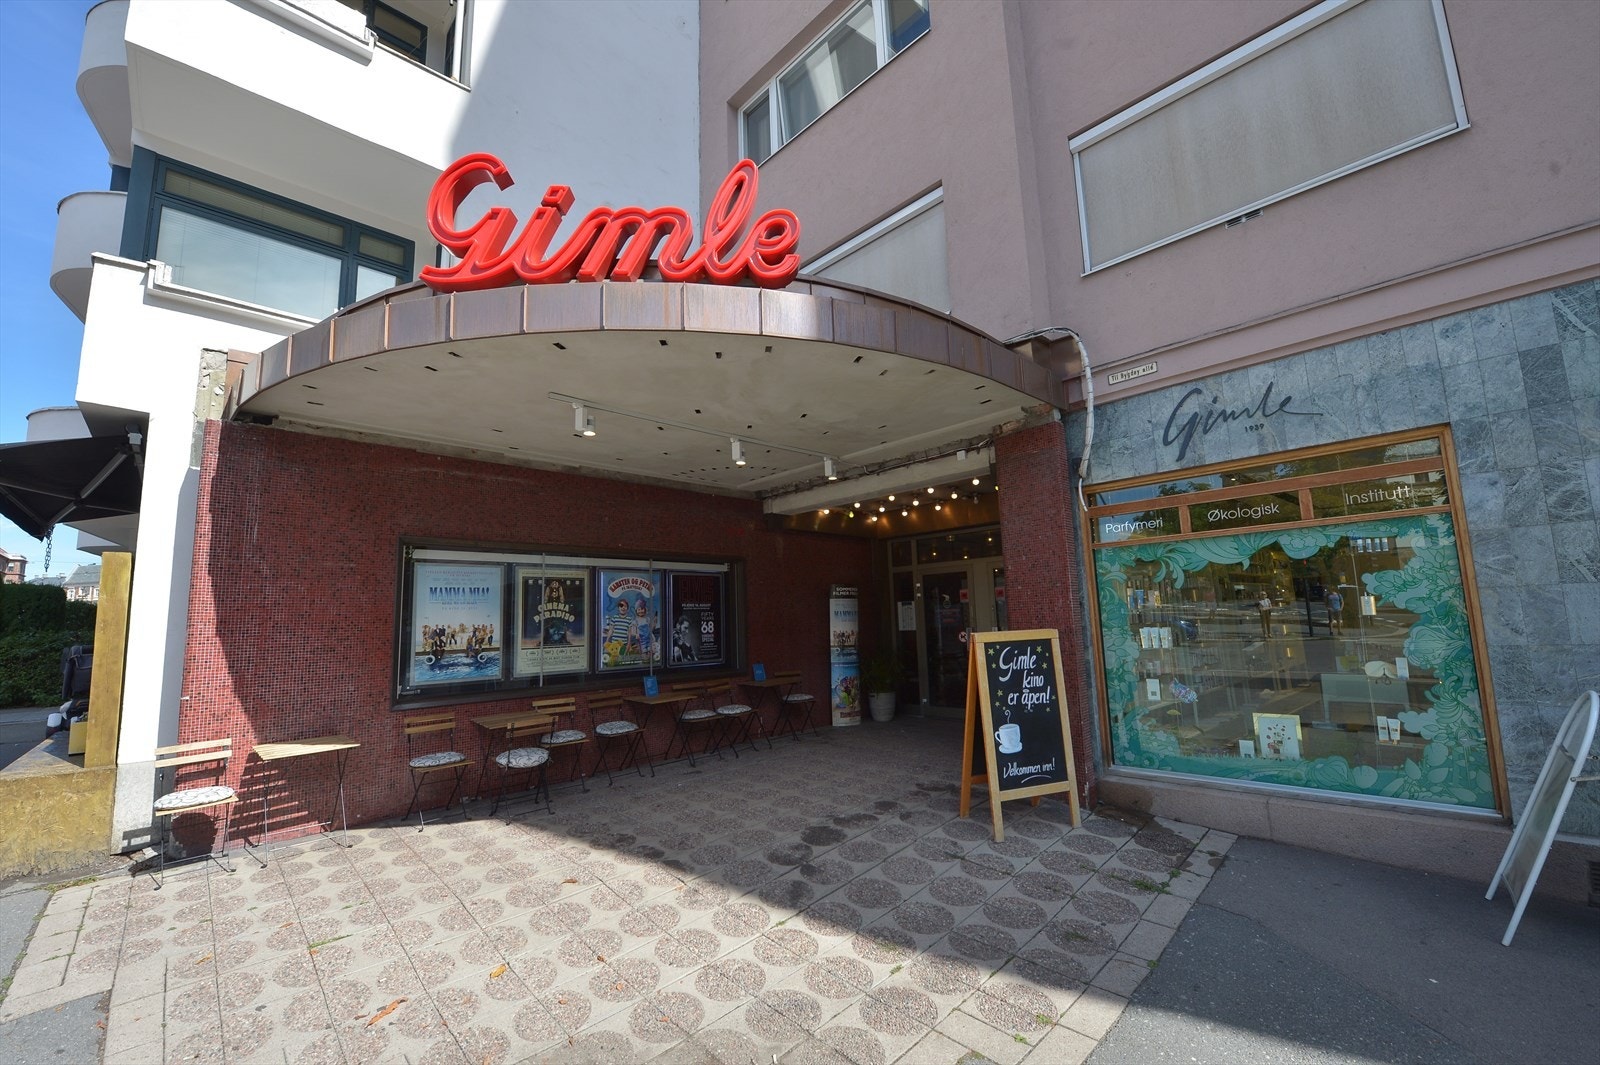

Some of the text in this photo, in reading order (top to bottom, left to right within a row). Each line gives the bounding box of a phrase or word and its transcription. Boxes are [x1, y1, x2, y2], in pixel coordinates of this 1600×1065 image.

[419, 152, 801, 294] Gimle
[1111, 374, 1119, 382] Til
[1162, 381, 1324, 462] Gimle
[1244, 422, 1265, 433] 1939
[1345, 485, 1411, 505] Institutt
[1207, 502, 1280, 522] Økologisk
[1105, 517, 1163, 534] Parfymeri
[429, 586, 490, 600] MAMMA MIA!
[537, 602, 570, 612] CINEMA
[533, 610, 576, 623] PARADISO
[701, 620, 715, 634] '68
[998, 646, 1038, 682] Gimle
[1022, 670, 1045, 688] kino
[1007, 685, 1051, 710] er åpen!
[1003, 756, 1056, 779] Velkommen inn!
